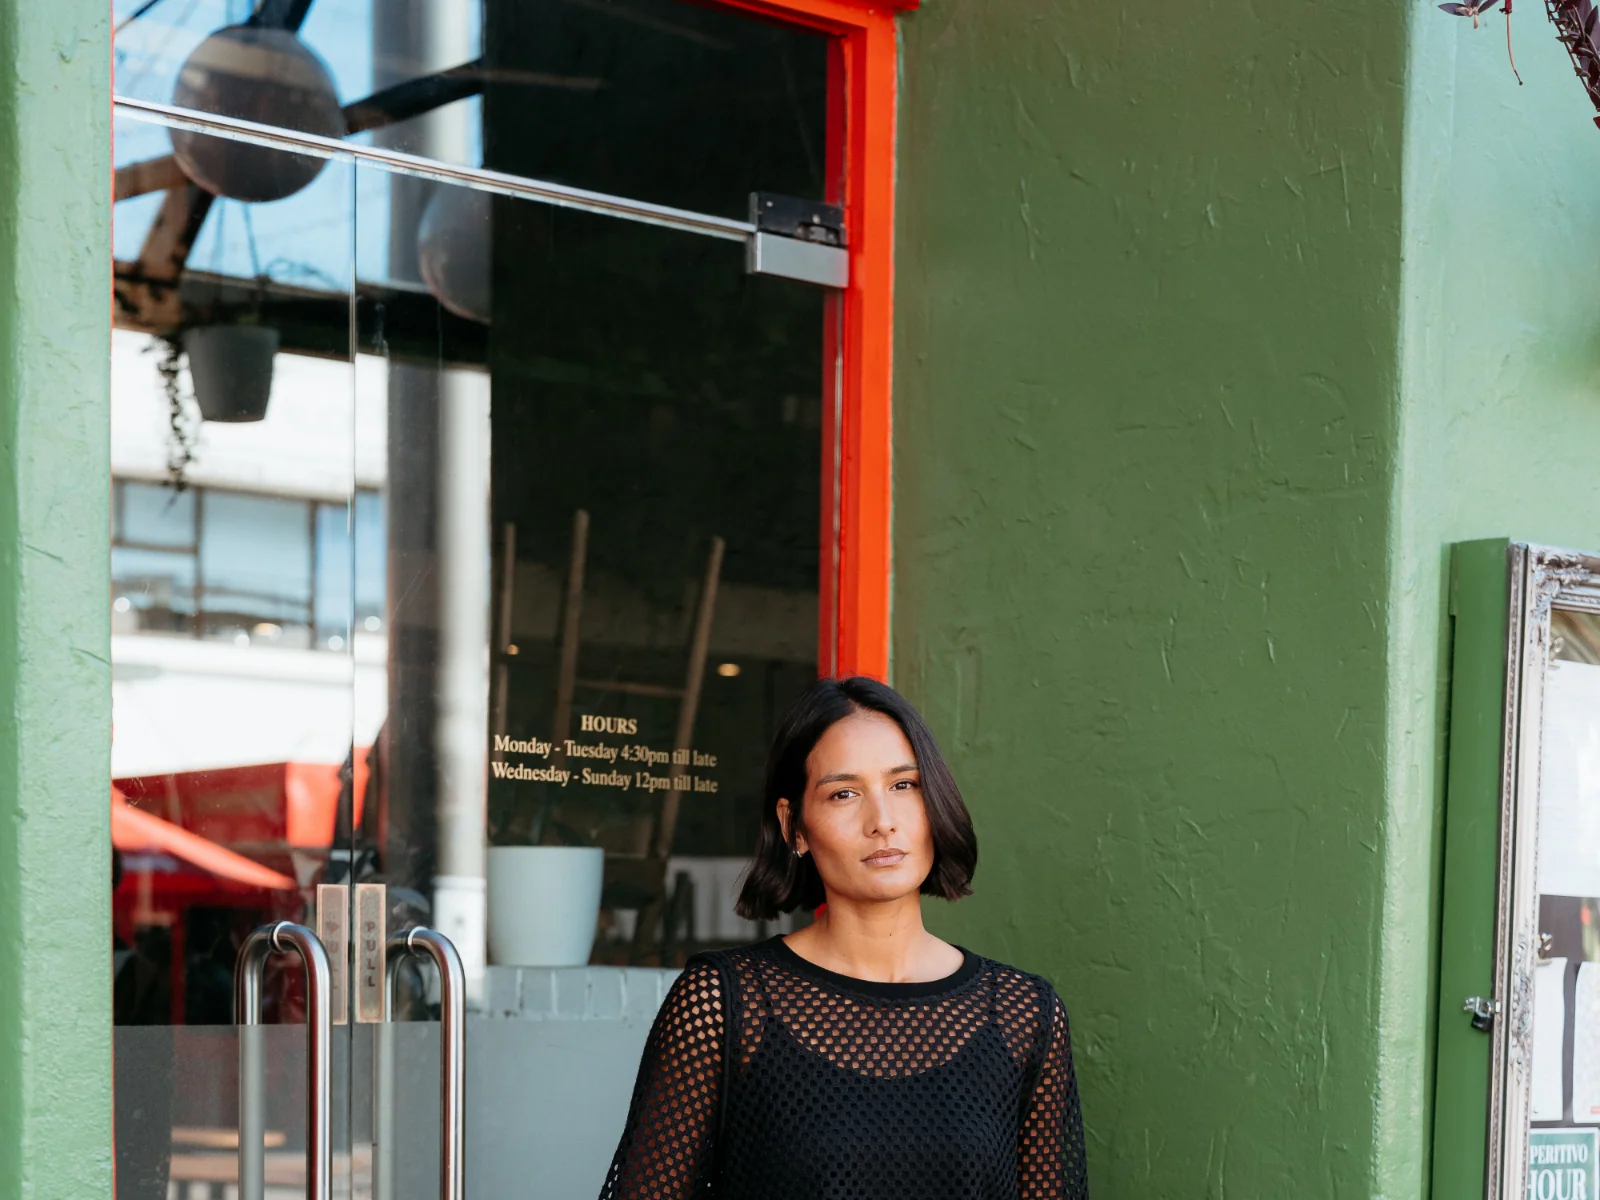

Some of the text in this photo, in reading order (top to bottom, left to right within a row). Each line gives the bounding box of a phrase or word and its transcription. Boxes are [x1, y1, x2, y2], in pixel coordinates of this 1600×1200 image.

[581, 714, 638, 735] HOURS
[494, 734, 552, 759] Monday
[563, 739, 618, 764] Tuesday
[621, 744, 669, 767] 4:30pm
[672, 748, 690, 766] till
[692, 749, 717, 767] late
[491, 761, 571, 787] Wednesday
[581, 767, 632, 791] Sunday
[635, 771, 670, 793] 12pm
[673, 774, 691, 791] till
[694, 775, 718, 793] late
[365, 920, 377, 988] PULL
[1530, 1143, 1588, 1165] PERITIVO
